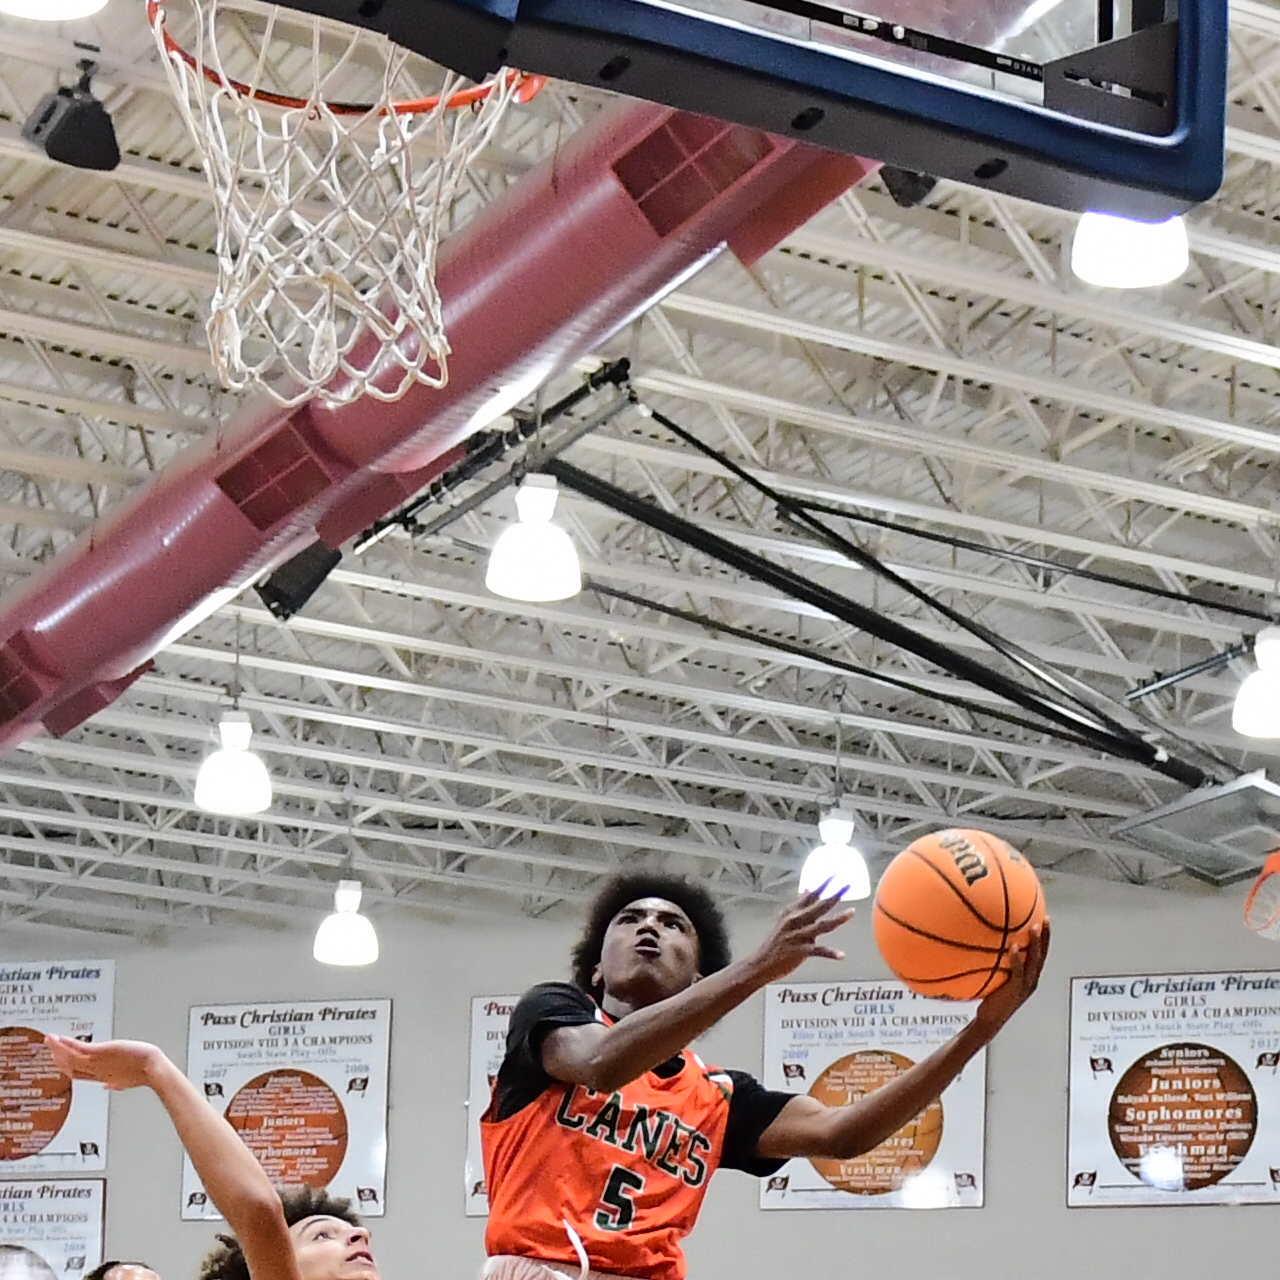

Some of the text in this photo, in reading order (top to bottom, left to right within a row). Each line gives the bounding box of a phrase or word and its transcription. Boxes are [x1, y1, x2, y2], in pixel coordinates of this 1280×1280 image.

[46, 965, 101, 981] Pirates
[1084, 981, 1125, 996] Pass
[1130, 978, 1215, 998] Christian
[30, 993, 97, 1004] CHAMPIONS
[778, 989, 817, 1004] Pass
[822, 986, 903, 1006] Christian
[1164, 996, 1206, 1006] GIRLS
[484, 1001, 517, 1016] Pas
[853, 1003, 895, 1015] GIRLS
[1087, 1011, 1147, 1022] DIVISION
[1152, 1010, 1175, 1020] VIII
[1191, 1009, 1199, 1019] A
[201, 1007, 377, 1028] Pass Christian Pirates
[781, 1017, 837, 1029] DIVISION
[842, 1016, 865, 1027] VIII
[880, 1016, 888, 1026] A
[892, 1014, 970, 1026] CHAMPIONS
[268, 1025, 305, 1036] GIRLS
[848, 1028, 875, 1038] South
[880, 1027, 903, 1037] State
[203, 1039, 254, 1050] DIVISION
[258, 1038, 279, 1048] VIII
[292, 1037, 299, 1047] A
[303, 1035, 373, 1046] CHAMPIONS
[1160, 1048, 1209, 1058] Seniors
[1148, 1078, 1221, 1093] Juniors
[263, 1116, 305, 1128] Juniors
[1125, 1106, 1242, 1123] Sophomores
[555, 1083, 712, 1189] CANES
[250, 1146, 317, 1159] ophomores
[37, 1184, 92, 1199] Pirates
[593, 1163, 646, 1231] 5
[21, 1212, 88, 1224] CHAMPIONS
